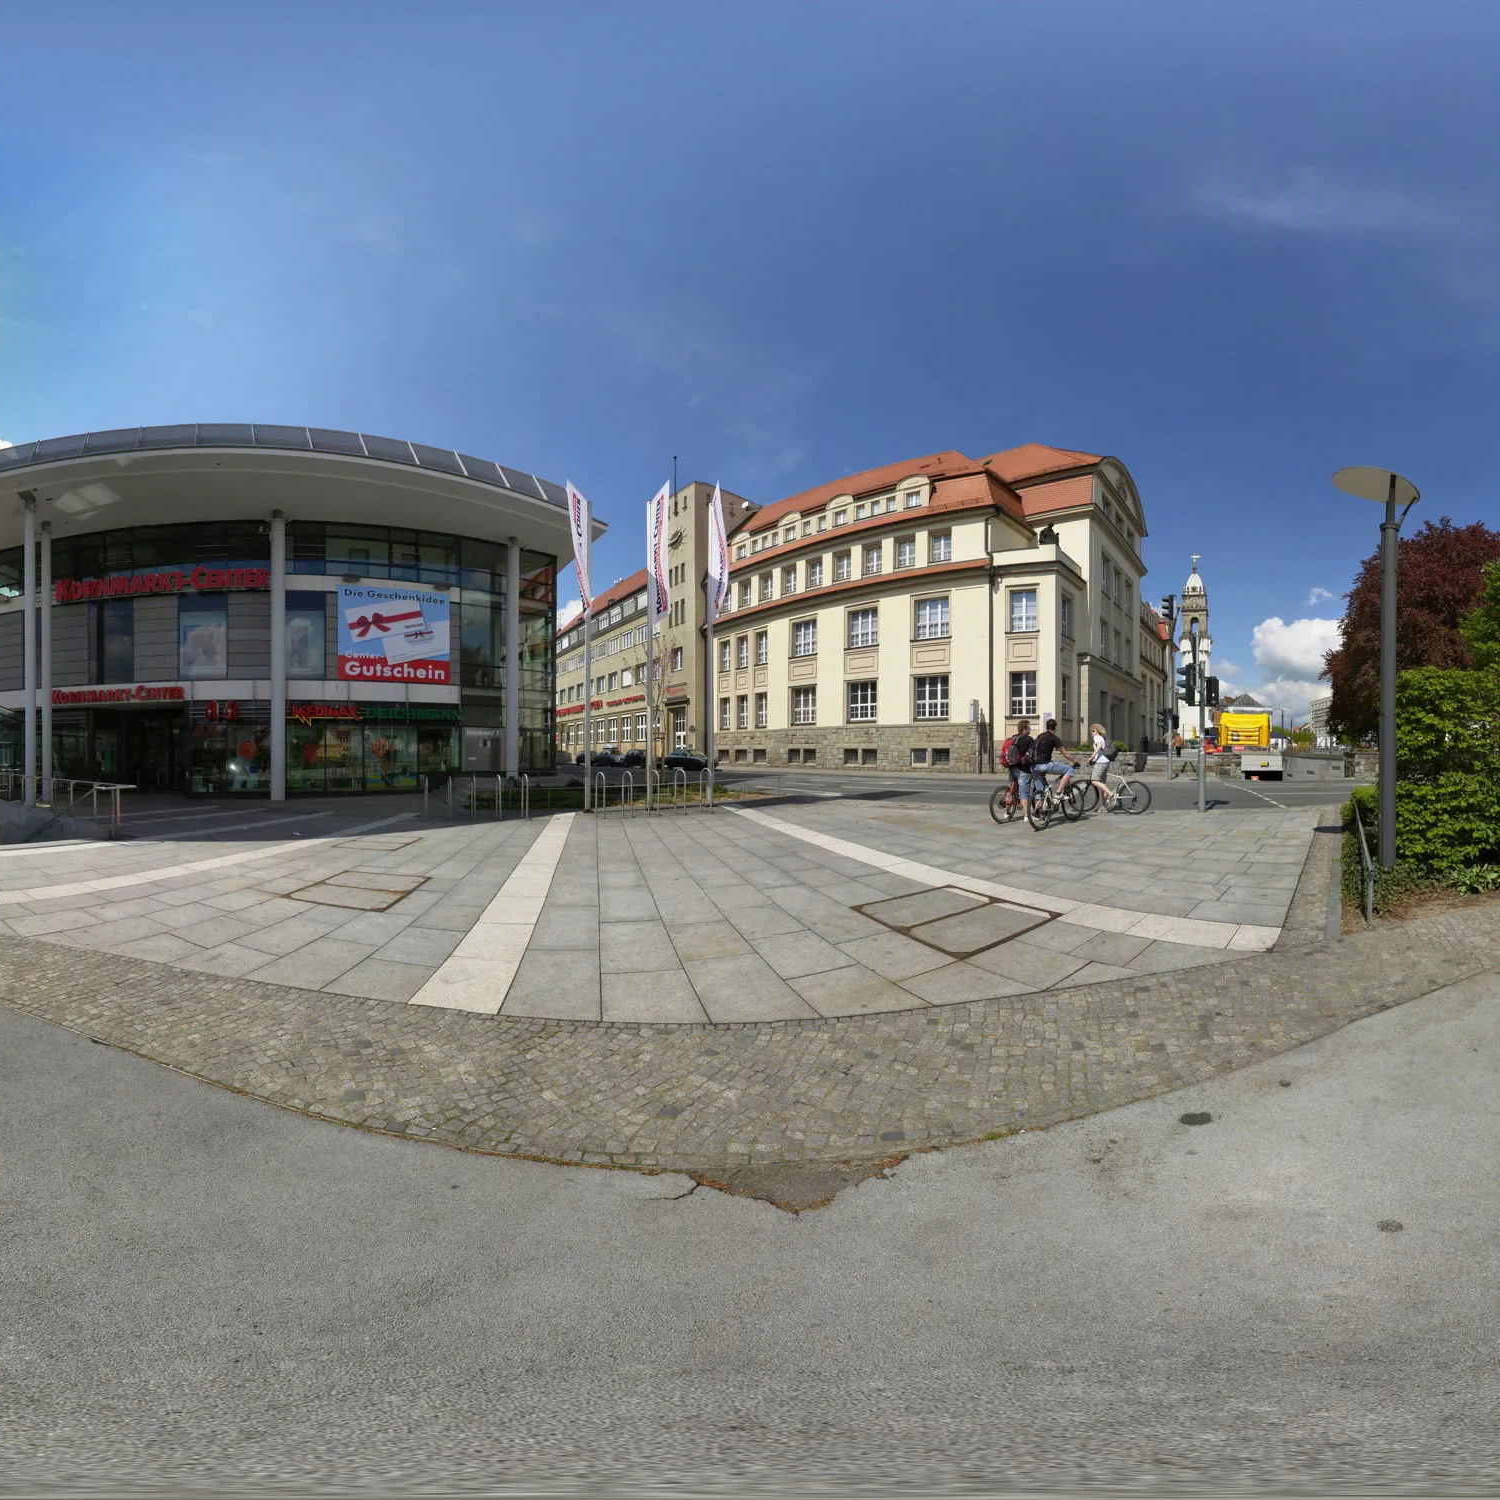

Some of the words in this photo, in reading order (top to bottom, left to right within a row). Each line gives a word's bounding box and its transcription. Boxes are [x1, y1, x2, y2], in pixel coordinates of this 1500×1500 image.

[55, 566, 270, 601] KORNMARKT-CENTER
[344, 588, 364, 597] Die
[367, 590, 445, 605] Geschenkidee
[344, 661, 445, 680] Gutschein
[52, 685, 185, 705] KORNMARKT-CENTER
[291, 703, 360, 721] MEDIMAX
[363, 707, 463, 721] DEICHMANN
